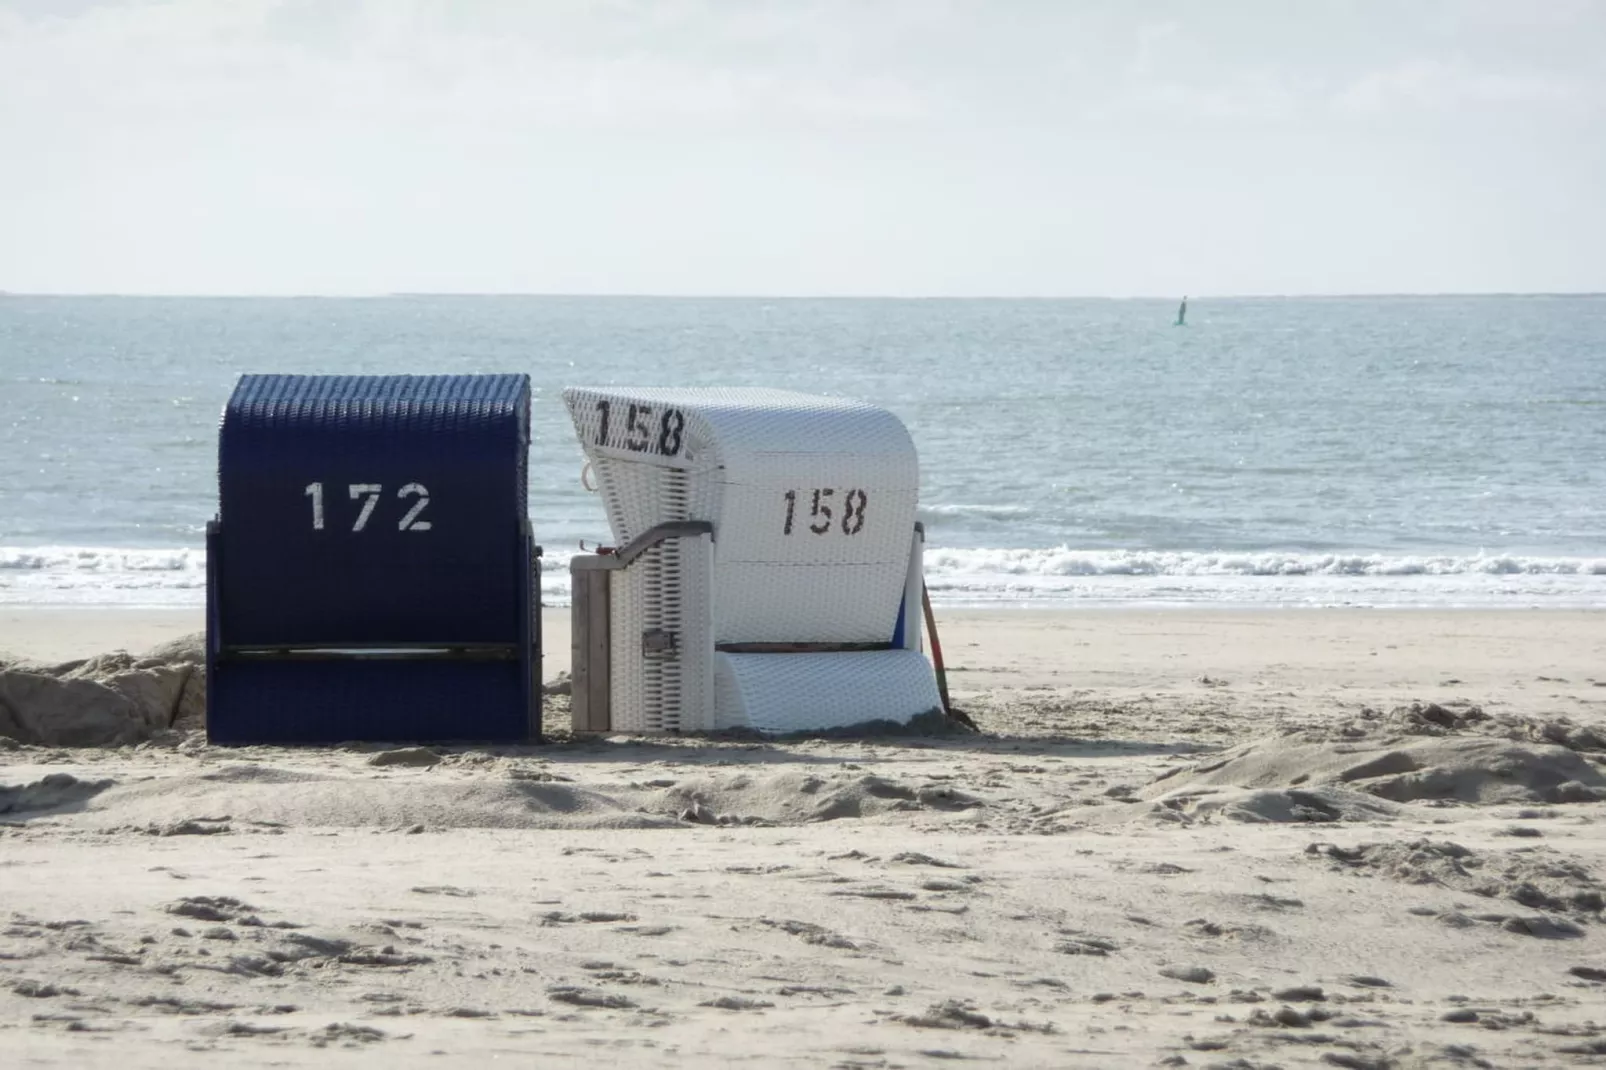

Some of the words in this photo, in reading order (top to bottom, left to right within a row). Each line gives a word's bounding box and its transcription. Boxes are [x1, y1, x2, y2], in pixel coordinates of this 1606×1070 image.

[596, 400, 684, 456] 158
[304, 482, 432, 531] 172
[783, 489, 867, 536] 158
